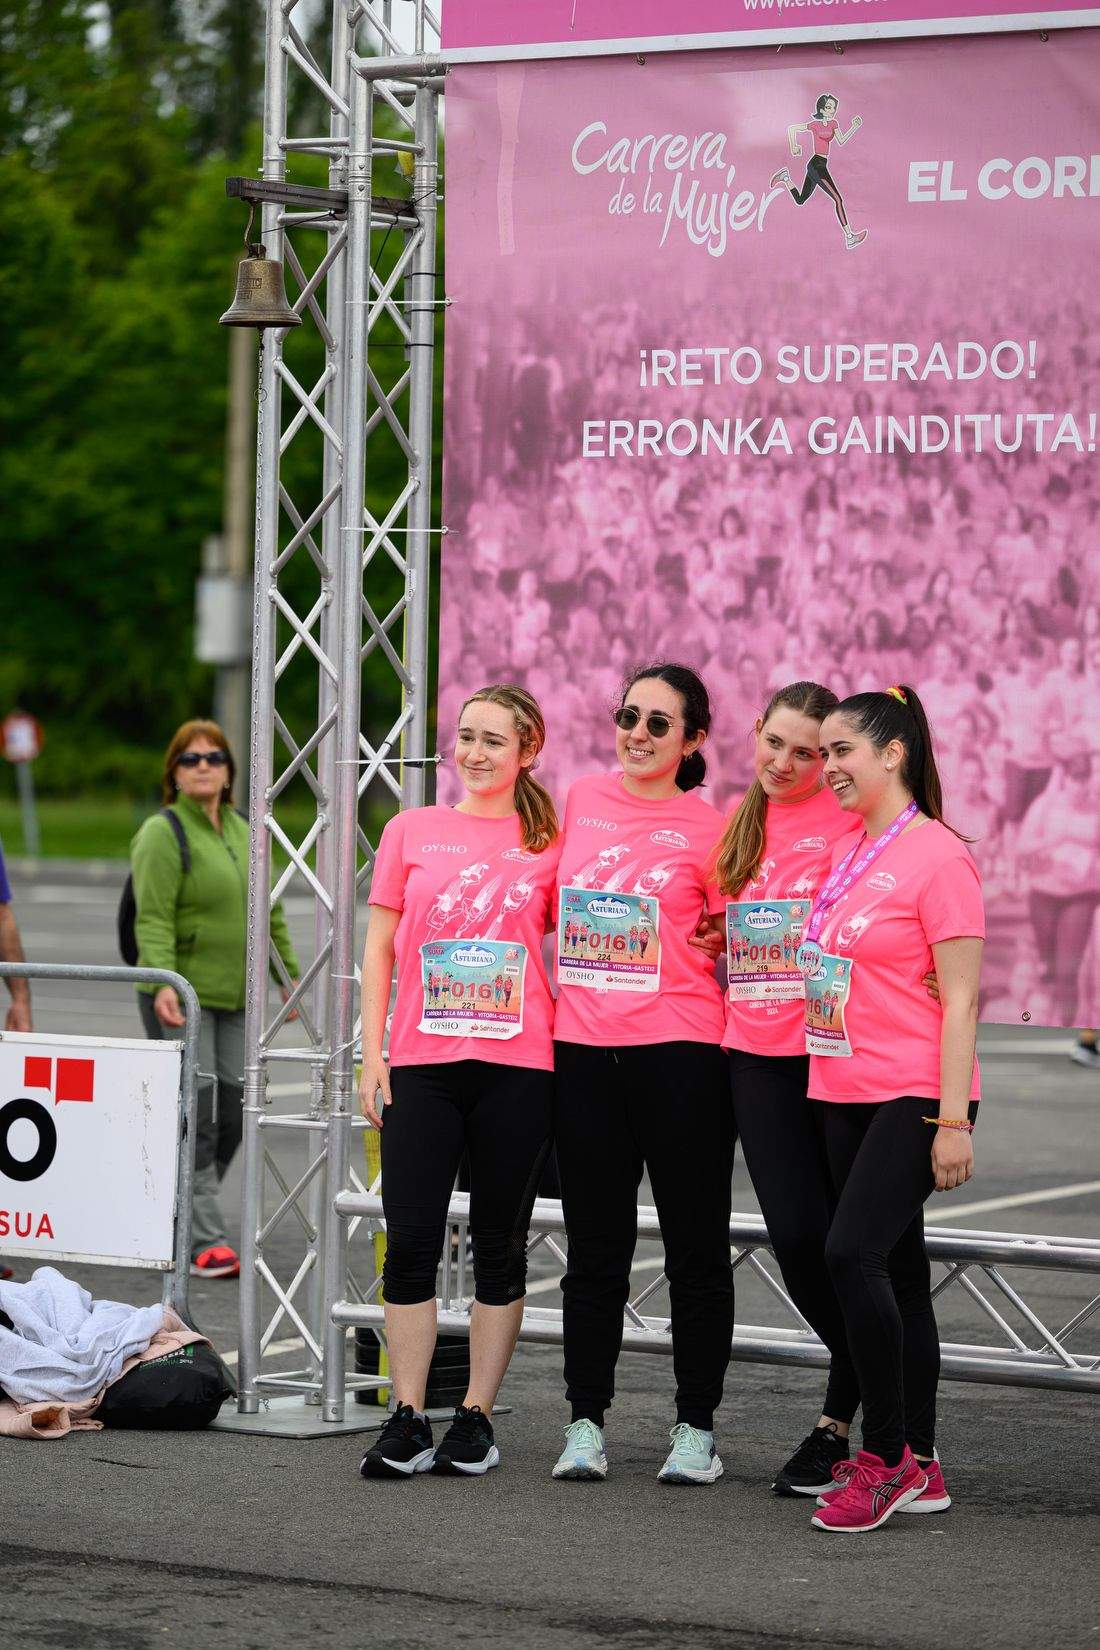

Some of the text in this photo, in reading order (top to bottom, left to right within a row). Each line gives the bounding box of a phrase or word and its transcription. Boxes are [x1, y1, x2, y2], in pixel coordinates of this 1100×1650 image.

[571, 121, 727, 175] Carrera
[907, 160, 968, 202] EL
[608, 165, 785, 257] de la Mujer
[639, 340, 1037, 387] ¡RETO SUPERADO!
[582, 413, 1097, 458] ERRONKA GAINDITUTA!
[576, 816, 618, 832] OYSHO
[421, 843, 468, 855] OYSHO
[589, 903, 629, 915] ASTURIANA
[747, 916, 781, 925] ASTURIANA
[452, 953, 494, 964] ASTURIANA
[597, 953, 611, 961] 224
[749, 944, 782, 961] 016
[756, 965, 769, 973] 219
[566, 970, 647, 985] OYSHO Santander
[451, 981, 493, 999] 016
[461, 1002, 476, 1010] 221
[430, 1021, 510, 1034] OYSHO Santander
[814, 1041, 840, 1050] Santander
